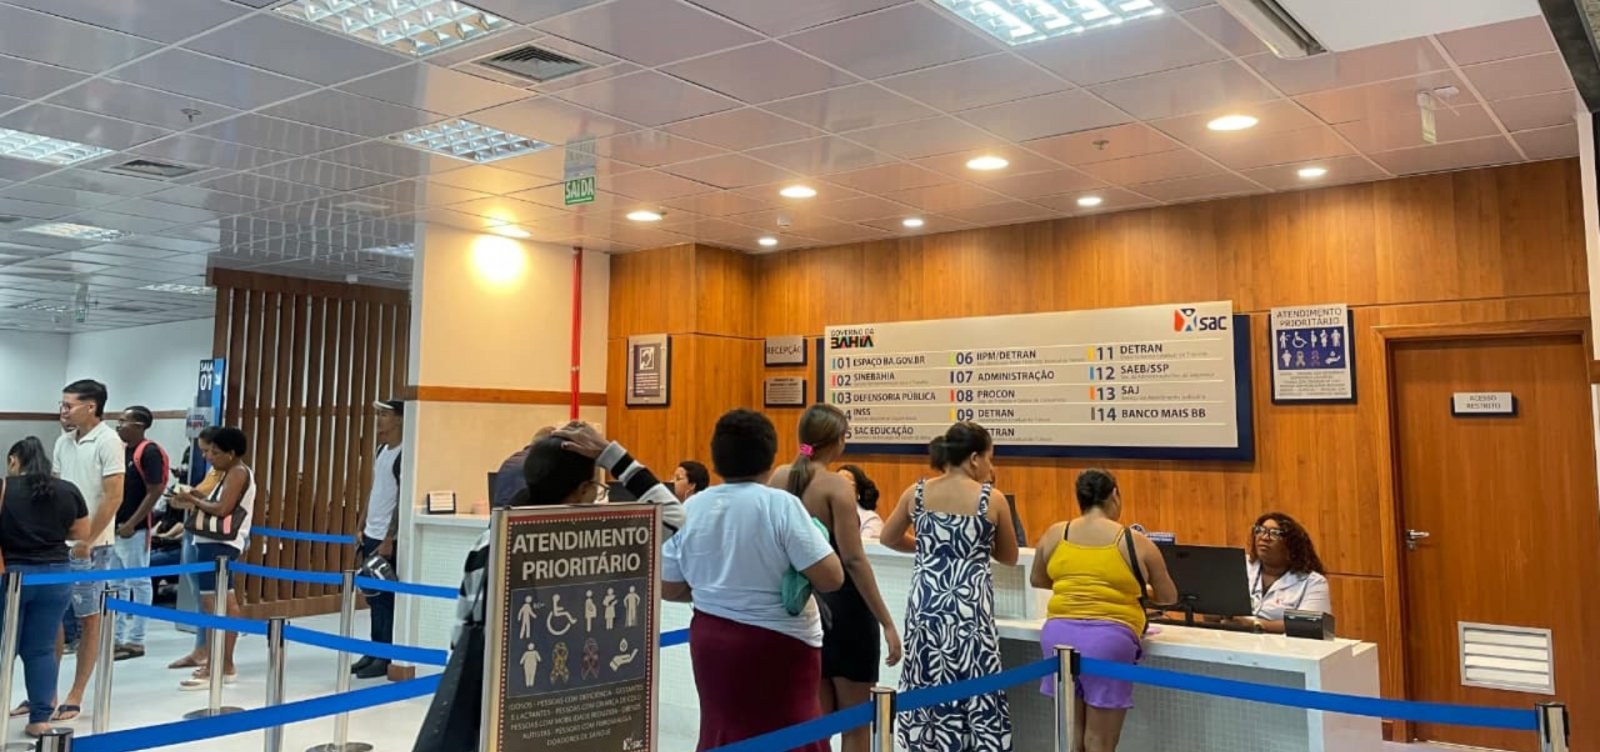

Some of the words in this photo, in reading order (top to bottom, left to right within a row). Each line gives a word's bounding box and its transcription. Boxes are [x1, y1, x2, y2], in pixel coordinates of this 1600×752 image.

[1276, 308, 1342, 318] ATENDIMENTO
[1199, 316, 1227, 331] sac
[831, 329, 862, 337] GOVERNO
[831, 335, 874, 349] BAHIA
[955, 352, 973, 365] 06
[1096, 346, 1113, 360] 11
[1120, 344, 1163, 354] DETRAN
[837, 357, 851, 369] 01
[853, 358, 882, 368] ESPAÇO
[883, 355, 925, 366] BA.GOV.BR
[956, 370, 973, 383] 07
[977, 369, 1055, 381] ADMINISTRAÇÃO
[1096, 366, 1115, 380] 12
[1120, 364, 1169, 374] SAEB/SSP
[200, 373, 212, 391] 01
[837, 374, 851, 387] 02
[854, 372, 895, 381] SINEBAHIA
[837, 392, 852, 404] 03
[853, 393, 900, 402] DEFENSORIA
[902, 390, 936, 401] PÚBLICA
[956, 389, 973, 402] 08
[977, 389, 1015, 399] PROCON
[1096, 387, 1116, 400] 13
[1121, 385, 1140, 395] SAJ
[853, 408, 871, 416] INSS
[956, 409, 974, 421] 09
[978, 409, 1015, 418] DETRAN
[1097, 407, 1117, 421] 14
[1121, 409, 1158, 419] BANCO
[1161, 408, 1189, 418] MAIS
[1191, 408, 1206, 418] BB
[854, 427, 869, 435] SAC
[871, 425, 914, 436] EDUCAÇÃO
[512, 526, 650, 555] ATENDIMENTO
[522, 550, 641, 581] PRIORITÁRIO
